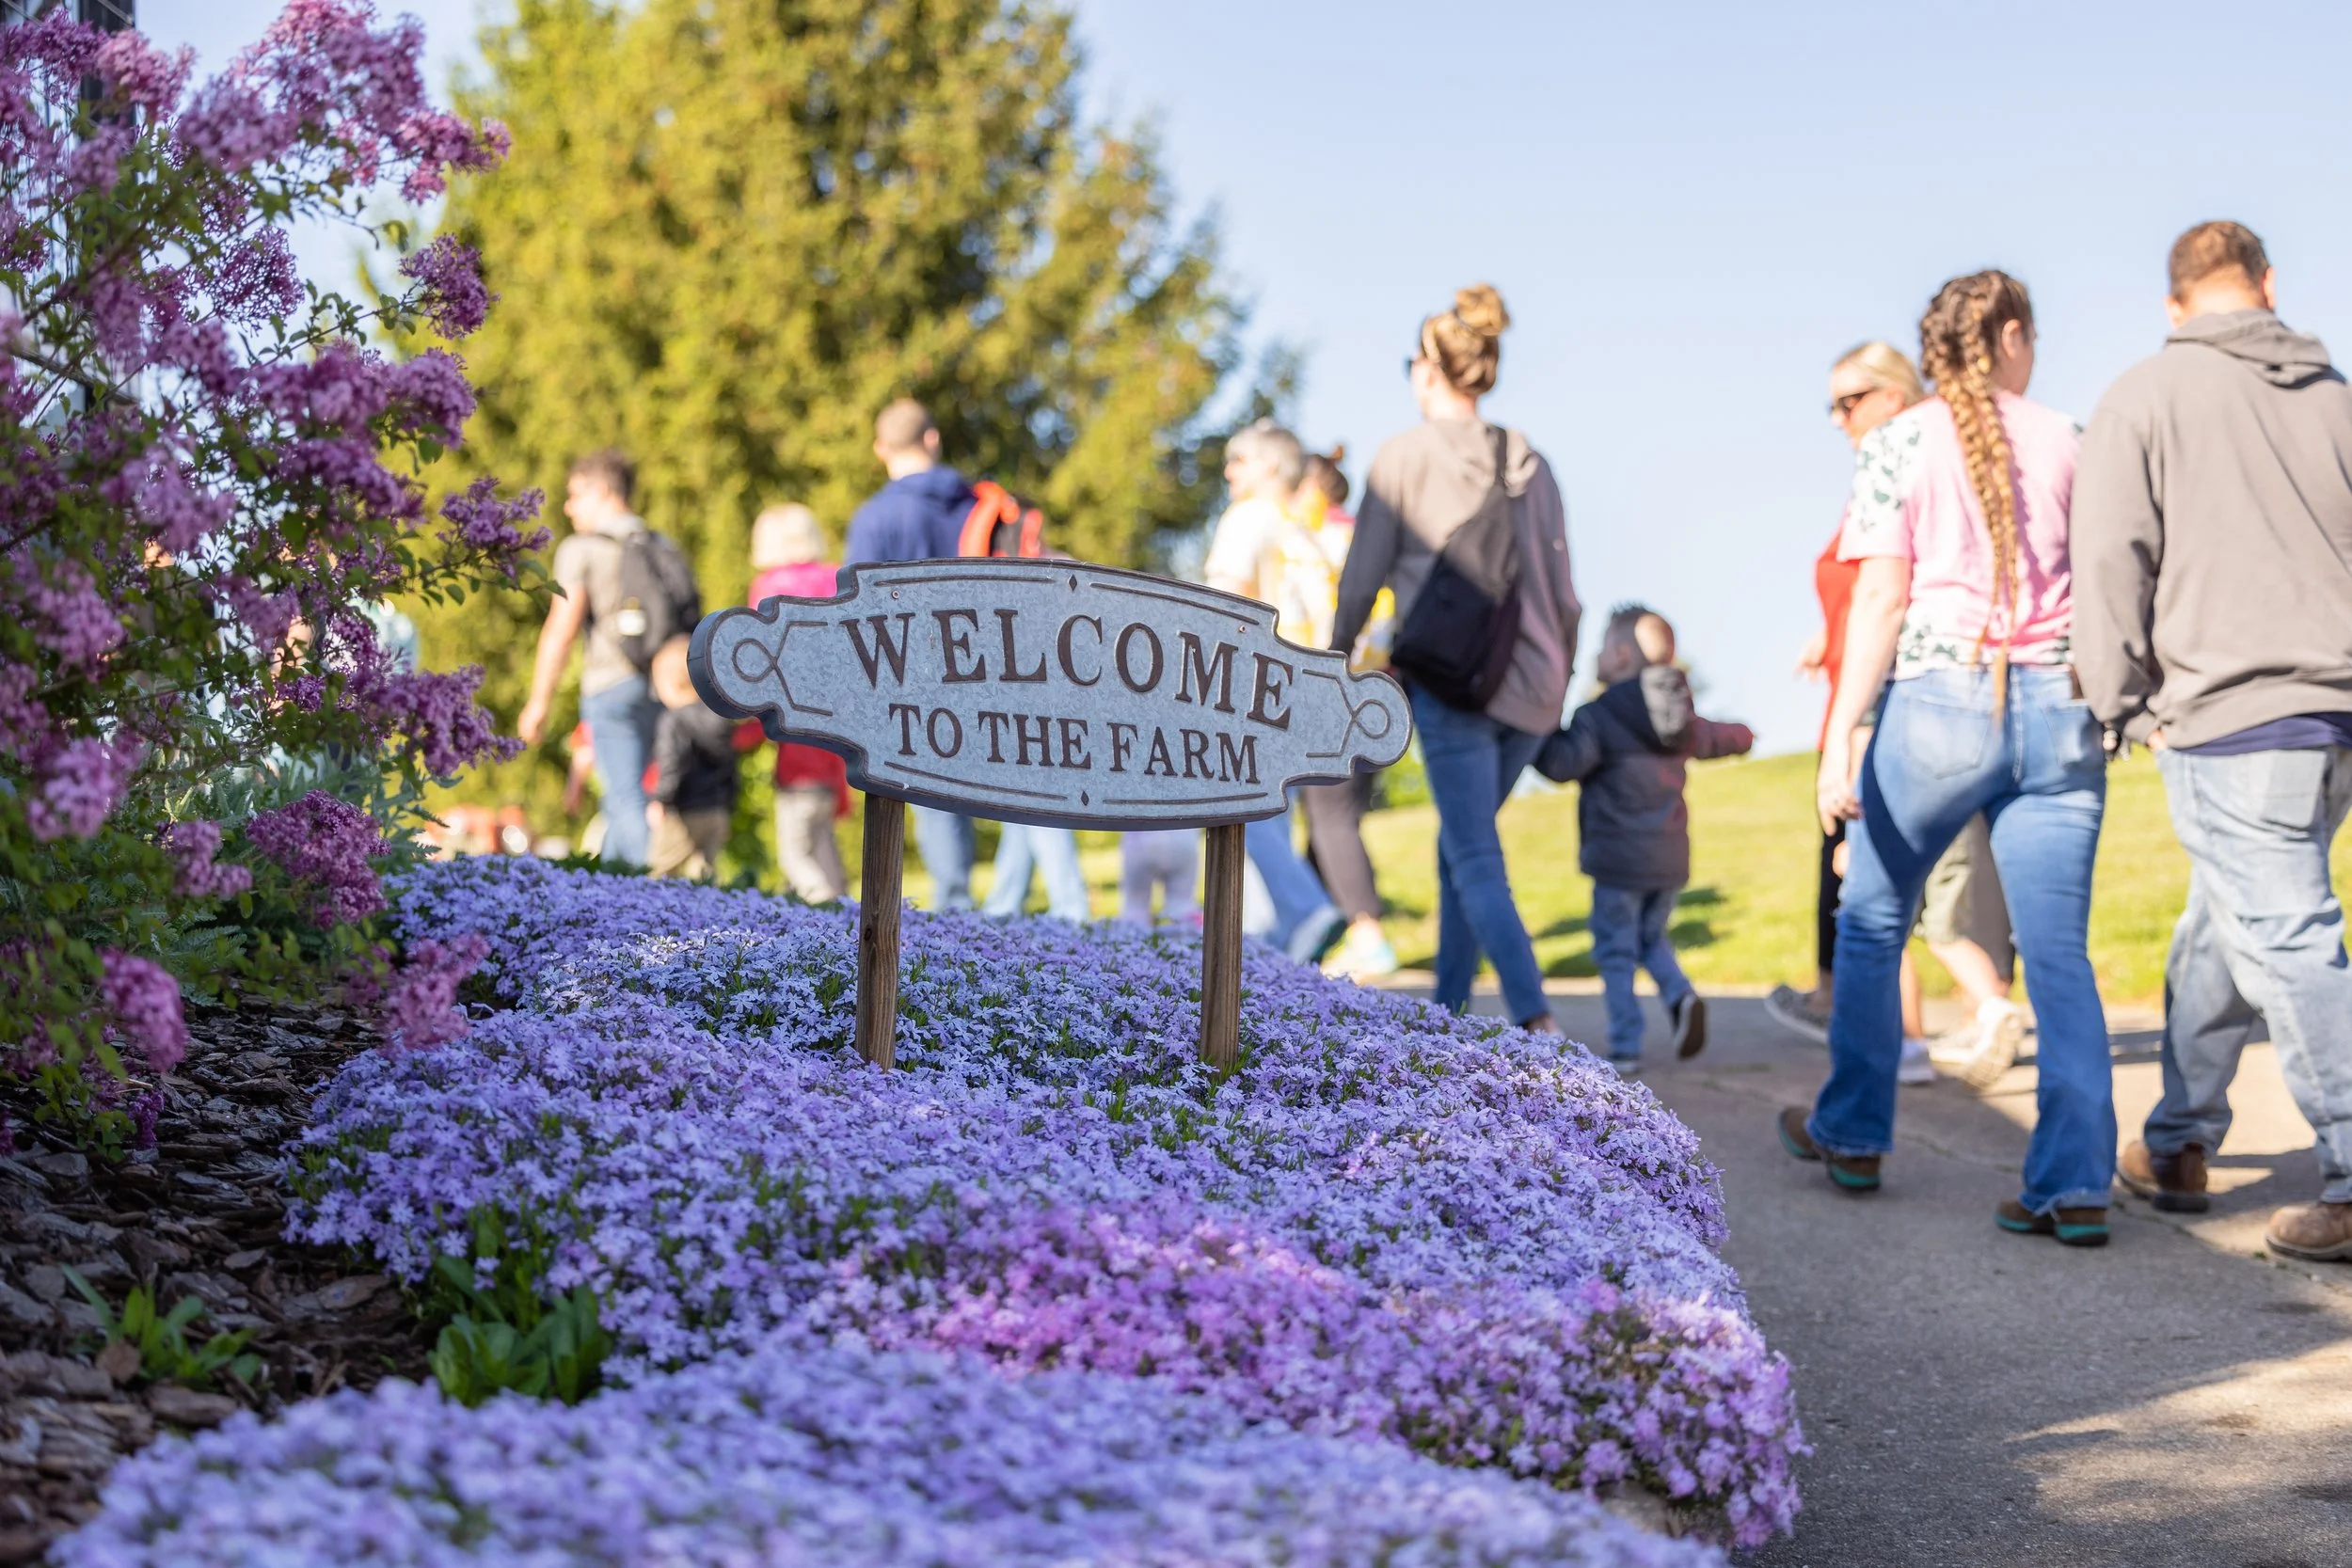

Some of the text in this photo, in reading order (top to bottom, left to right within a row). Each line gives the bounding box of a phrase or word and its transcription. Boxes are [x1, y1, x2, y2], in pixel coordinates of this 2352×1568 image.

[839, 608, 1294, 730] WELCOME
[889, 704, 1260, 784] TO THE FARM
